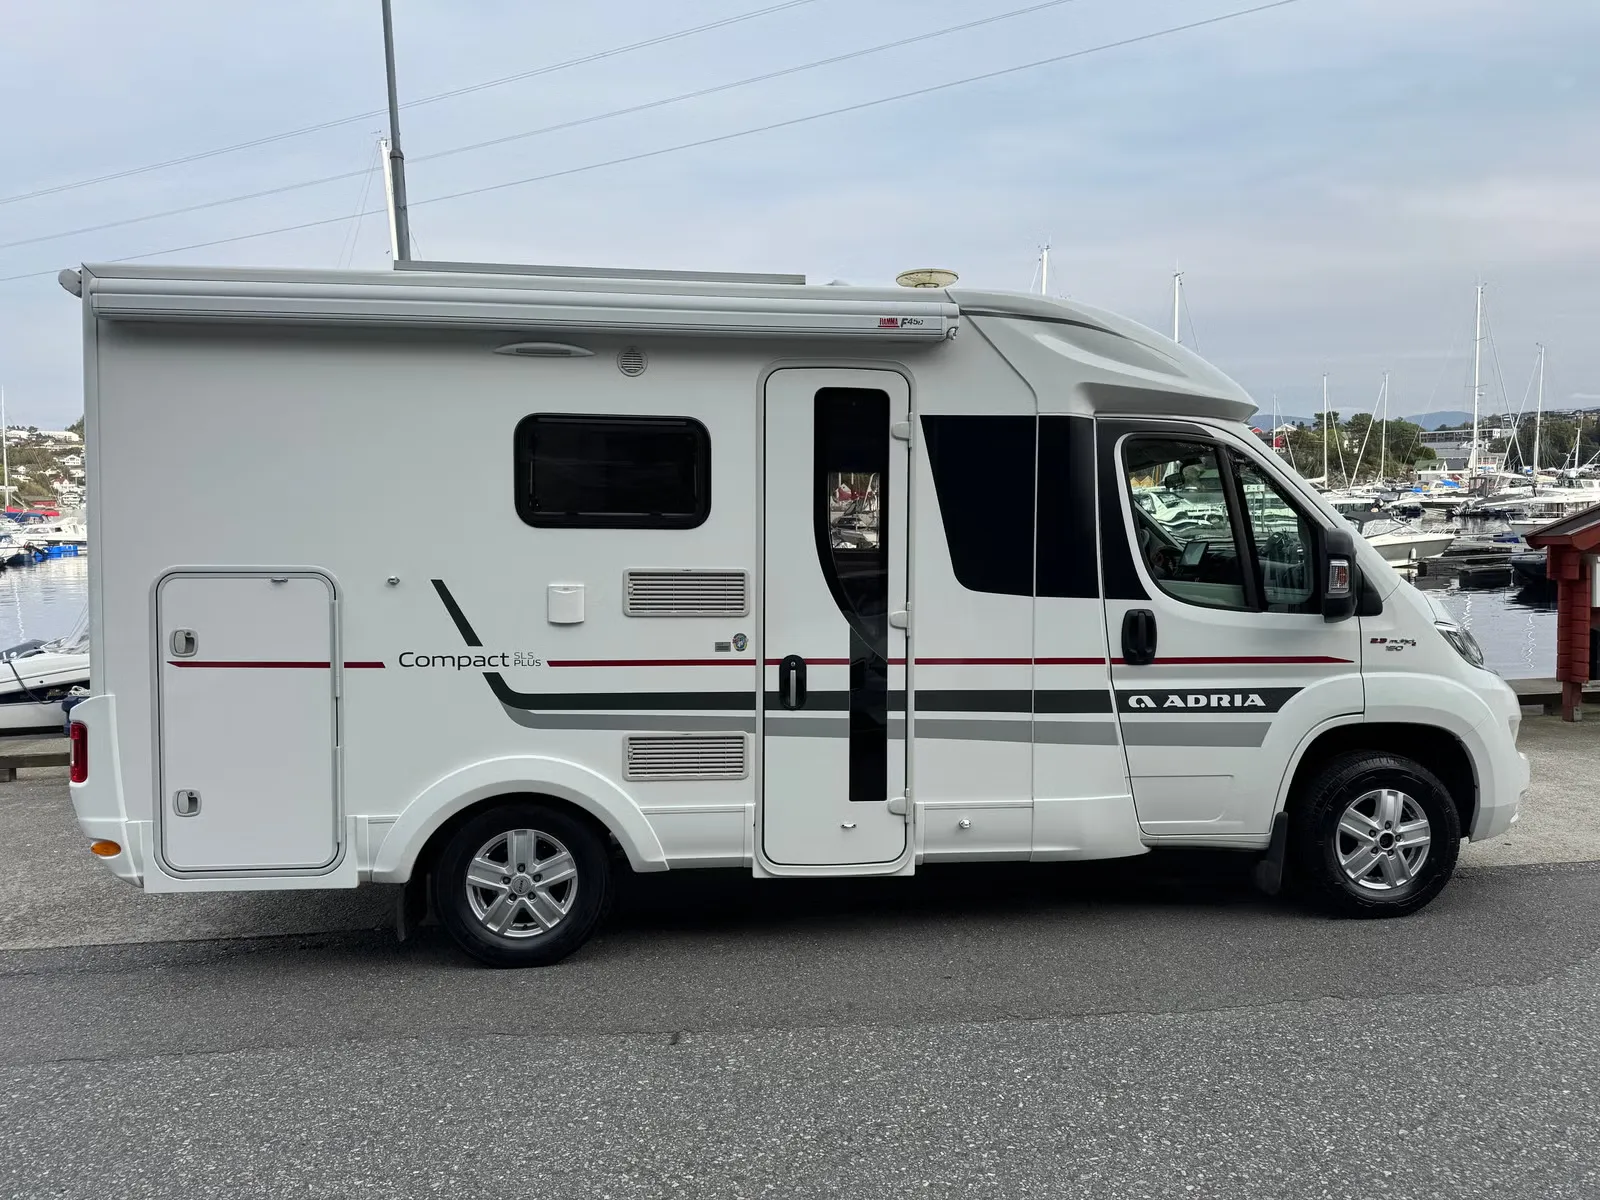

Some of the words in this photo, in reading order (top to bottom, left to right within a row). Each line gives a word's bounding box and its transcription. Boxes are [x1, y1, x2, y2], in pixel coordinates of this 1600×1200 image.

[398, 652, 510, 671] Compact
[513, 652, 534, 660] SLS
[513, 659, 542, 667] PLUS
[1162, 694, 1266, 708] ADRIA
